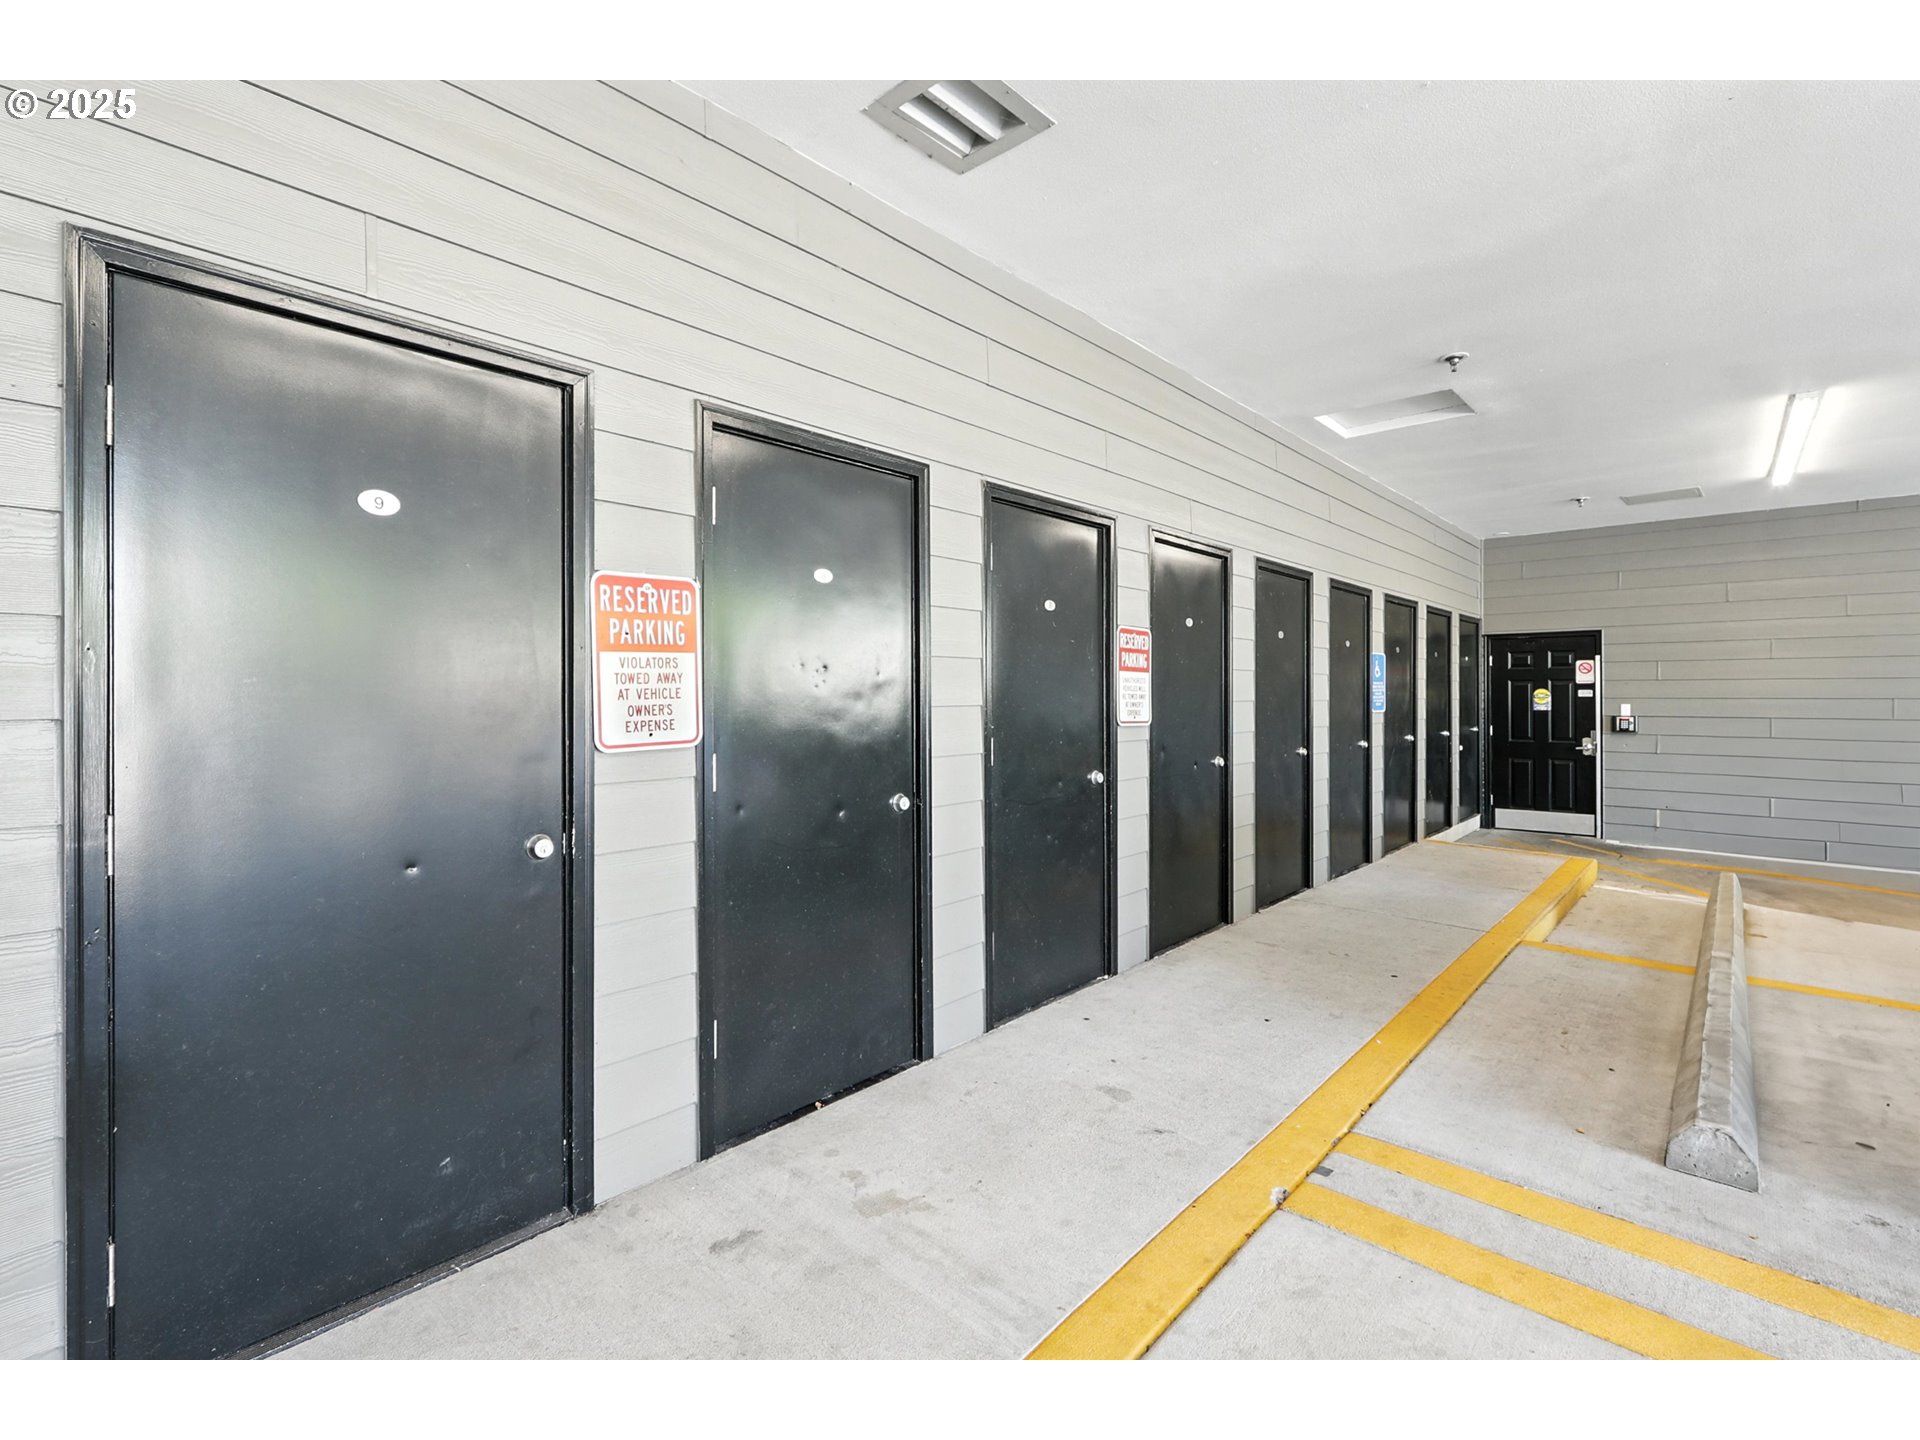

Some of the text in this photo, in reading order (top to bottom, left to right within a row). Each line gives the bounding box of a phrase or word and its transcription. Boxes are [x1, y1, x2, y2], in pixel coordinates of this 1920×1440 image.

[374, 496, 384, 510] 9
[600, 584, 692, 615] RESERVED
[609, 618, 686, 646] PARKING
[619, 657, 679, 669] VIOLATORS
[614, 672, 683, 685] TOWED AWAY
[617, 687, 681, 701] AT VEHICLE
[627, 703, 673, 717] OWNER'S
[625, 719, 675, 733] EXPENSE
